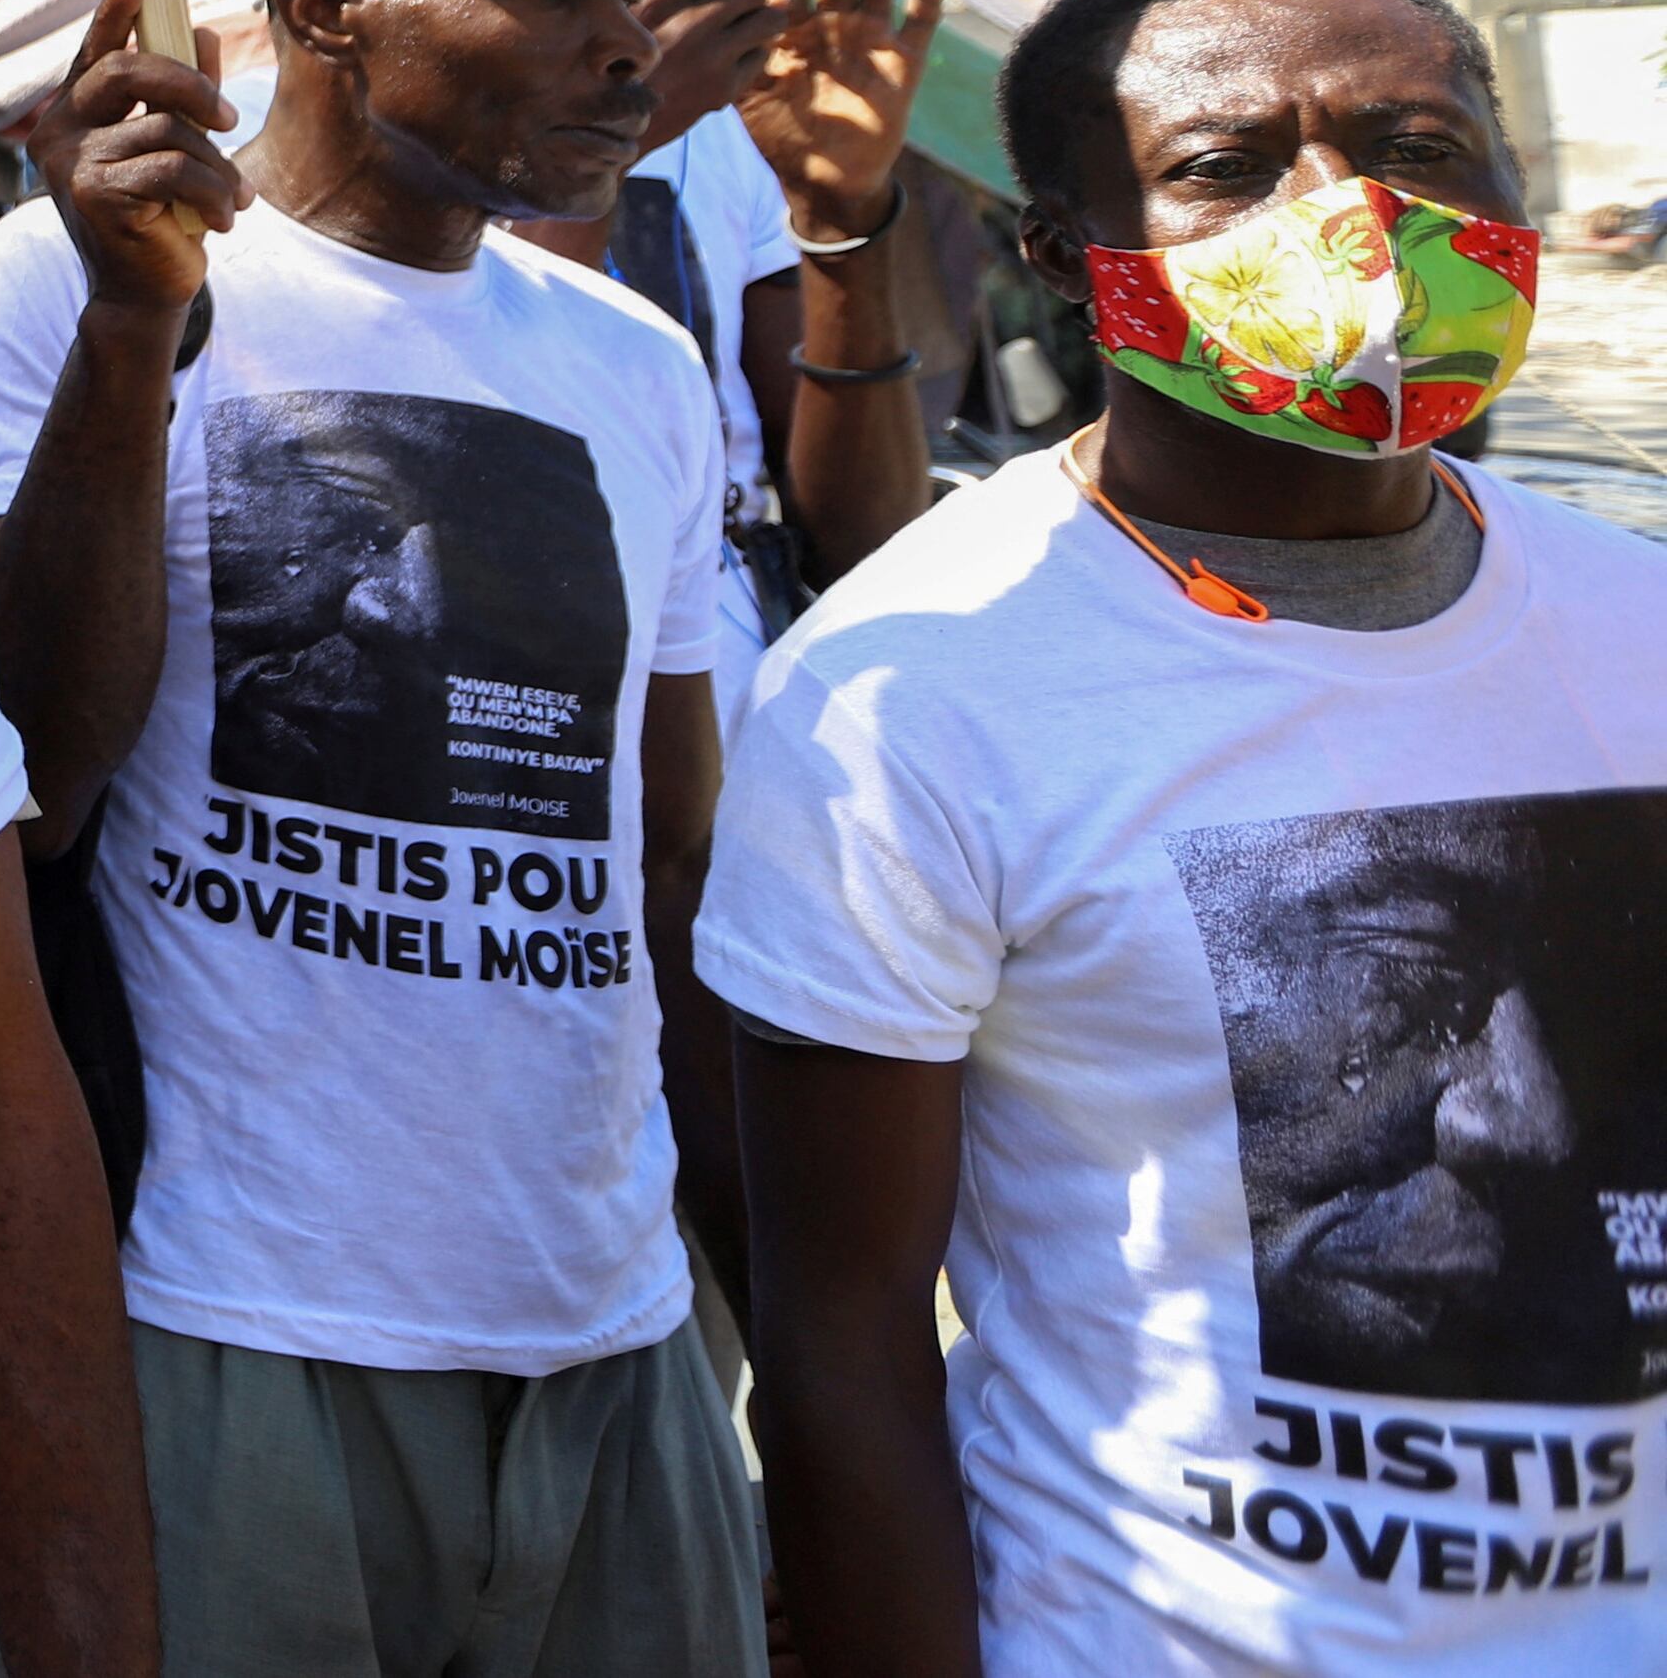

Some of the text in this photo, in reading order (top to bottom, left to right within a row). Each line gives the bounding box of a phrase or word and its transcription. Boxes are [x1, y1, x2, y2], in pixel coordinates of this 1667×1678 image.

[446, 691, 476, 710] OU
[546, 706, 574, 725] PA
[447, 739, 541, 768] KONTINYE
[202, 796, 609, 915] JISTIS POU
[449, 786, 571, 818] Jovenel MOISE
[149, 846, 633, 990] JOVENEL MOÏSE
[1252, 1394, 1637, 1512] JISTIS
[1181, 1466, 1651, 1598] JOVENEL
